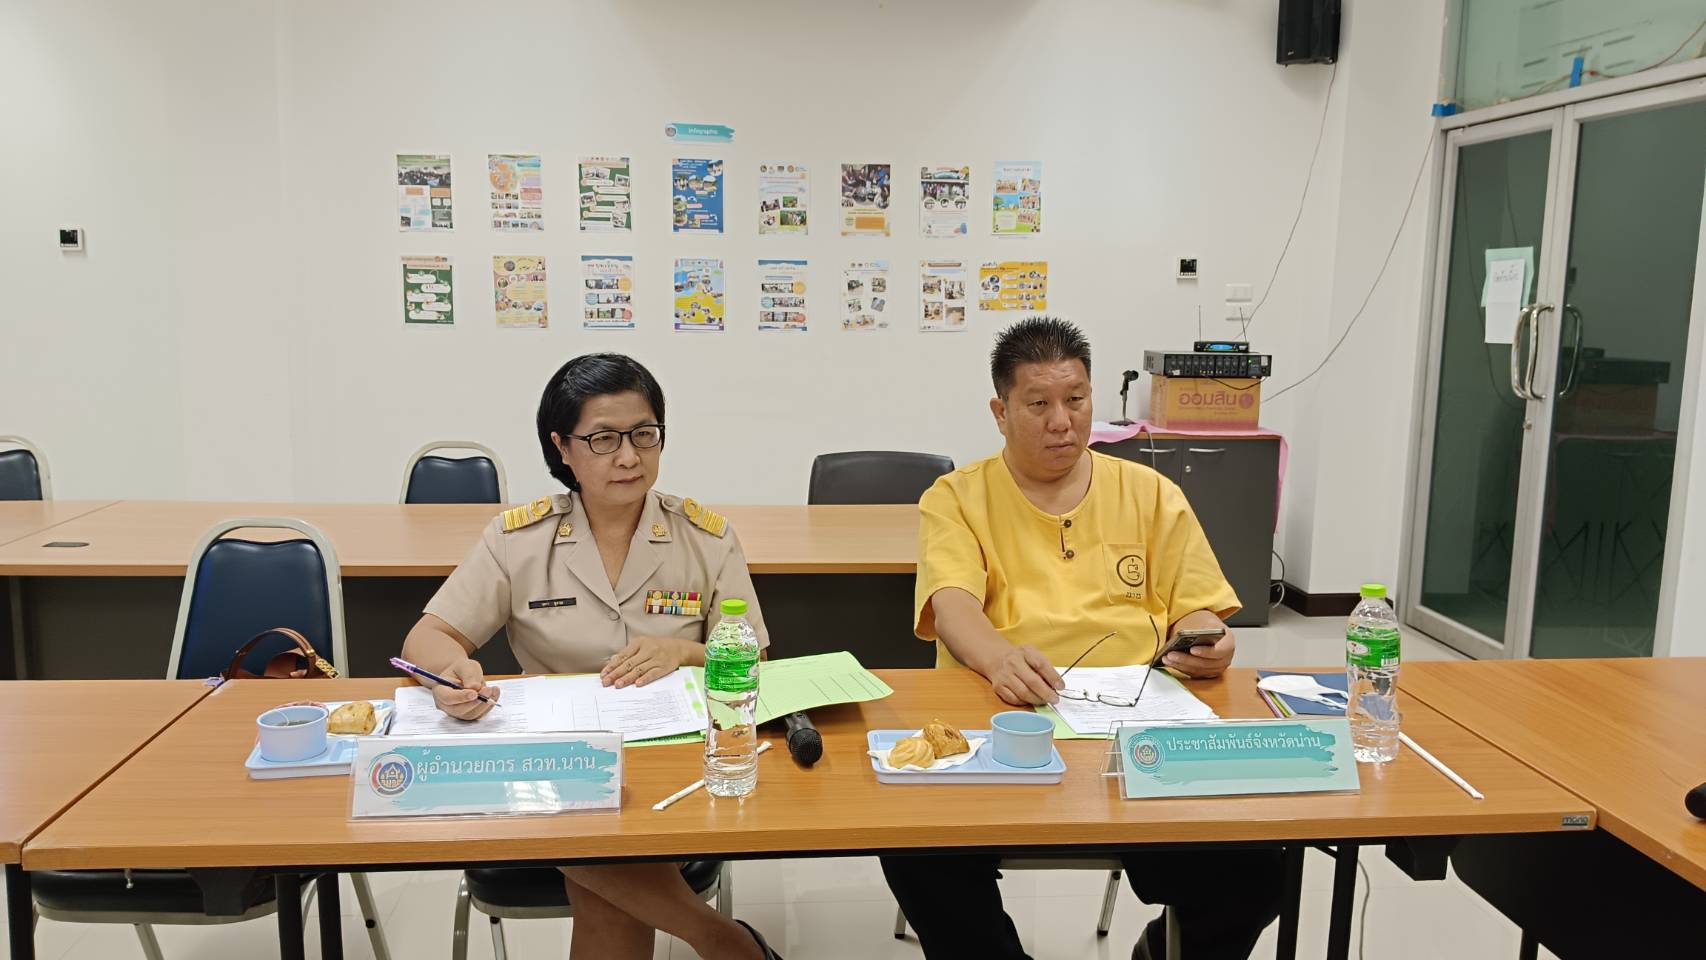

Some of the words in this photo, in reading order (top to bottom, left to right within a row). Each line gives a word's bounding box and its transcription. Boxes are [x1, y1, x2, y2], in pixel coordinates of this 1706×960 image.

[1166, 732, 1321, 752] ประชาสัมพันธ์จังหวัดน่าน
[416, 748, 515, 781] ผู้อำนวยการ
[521, 745, 597, 773] สวท.น่าน
